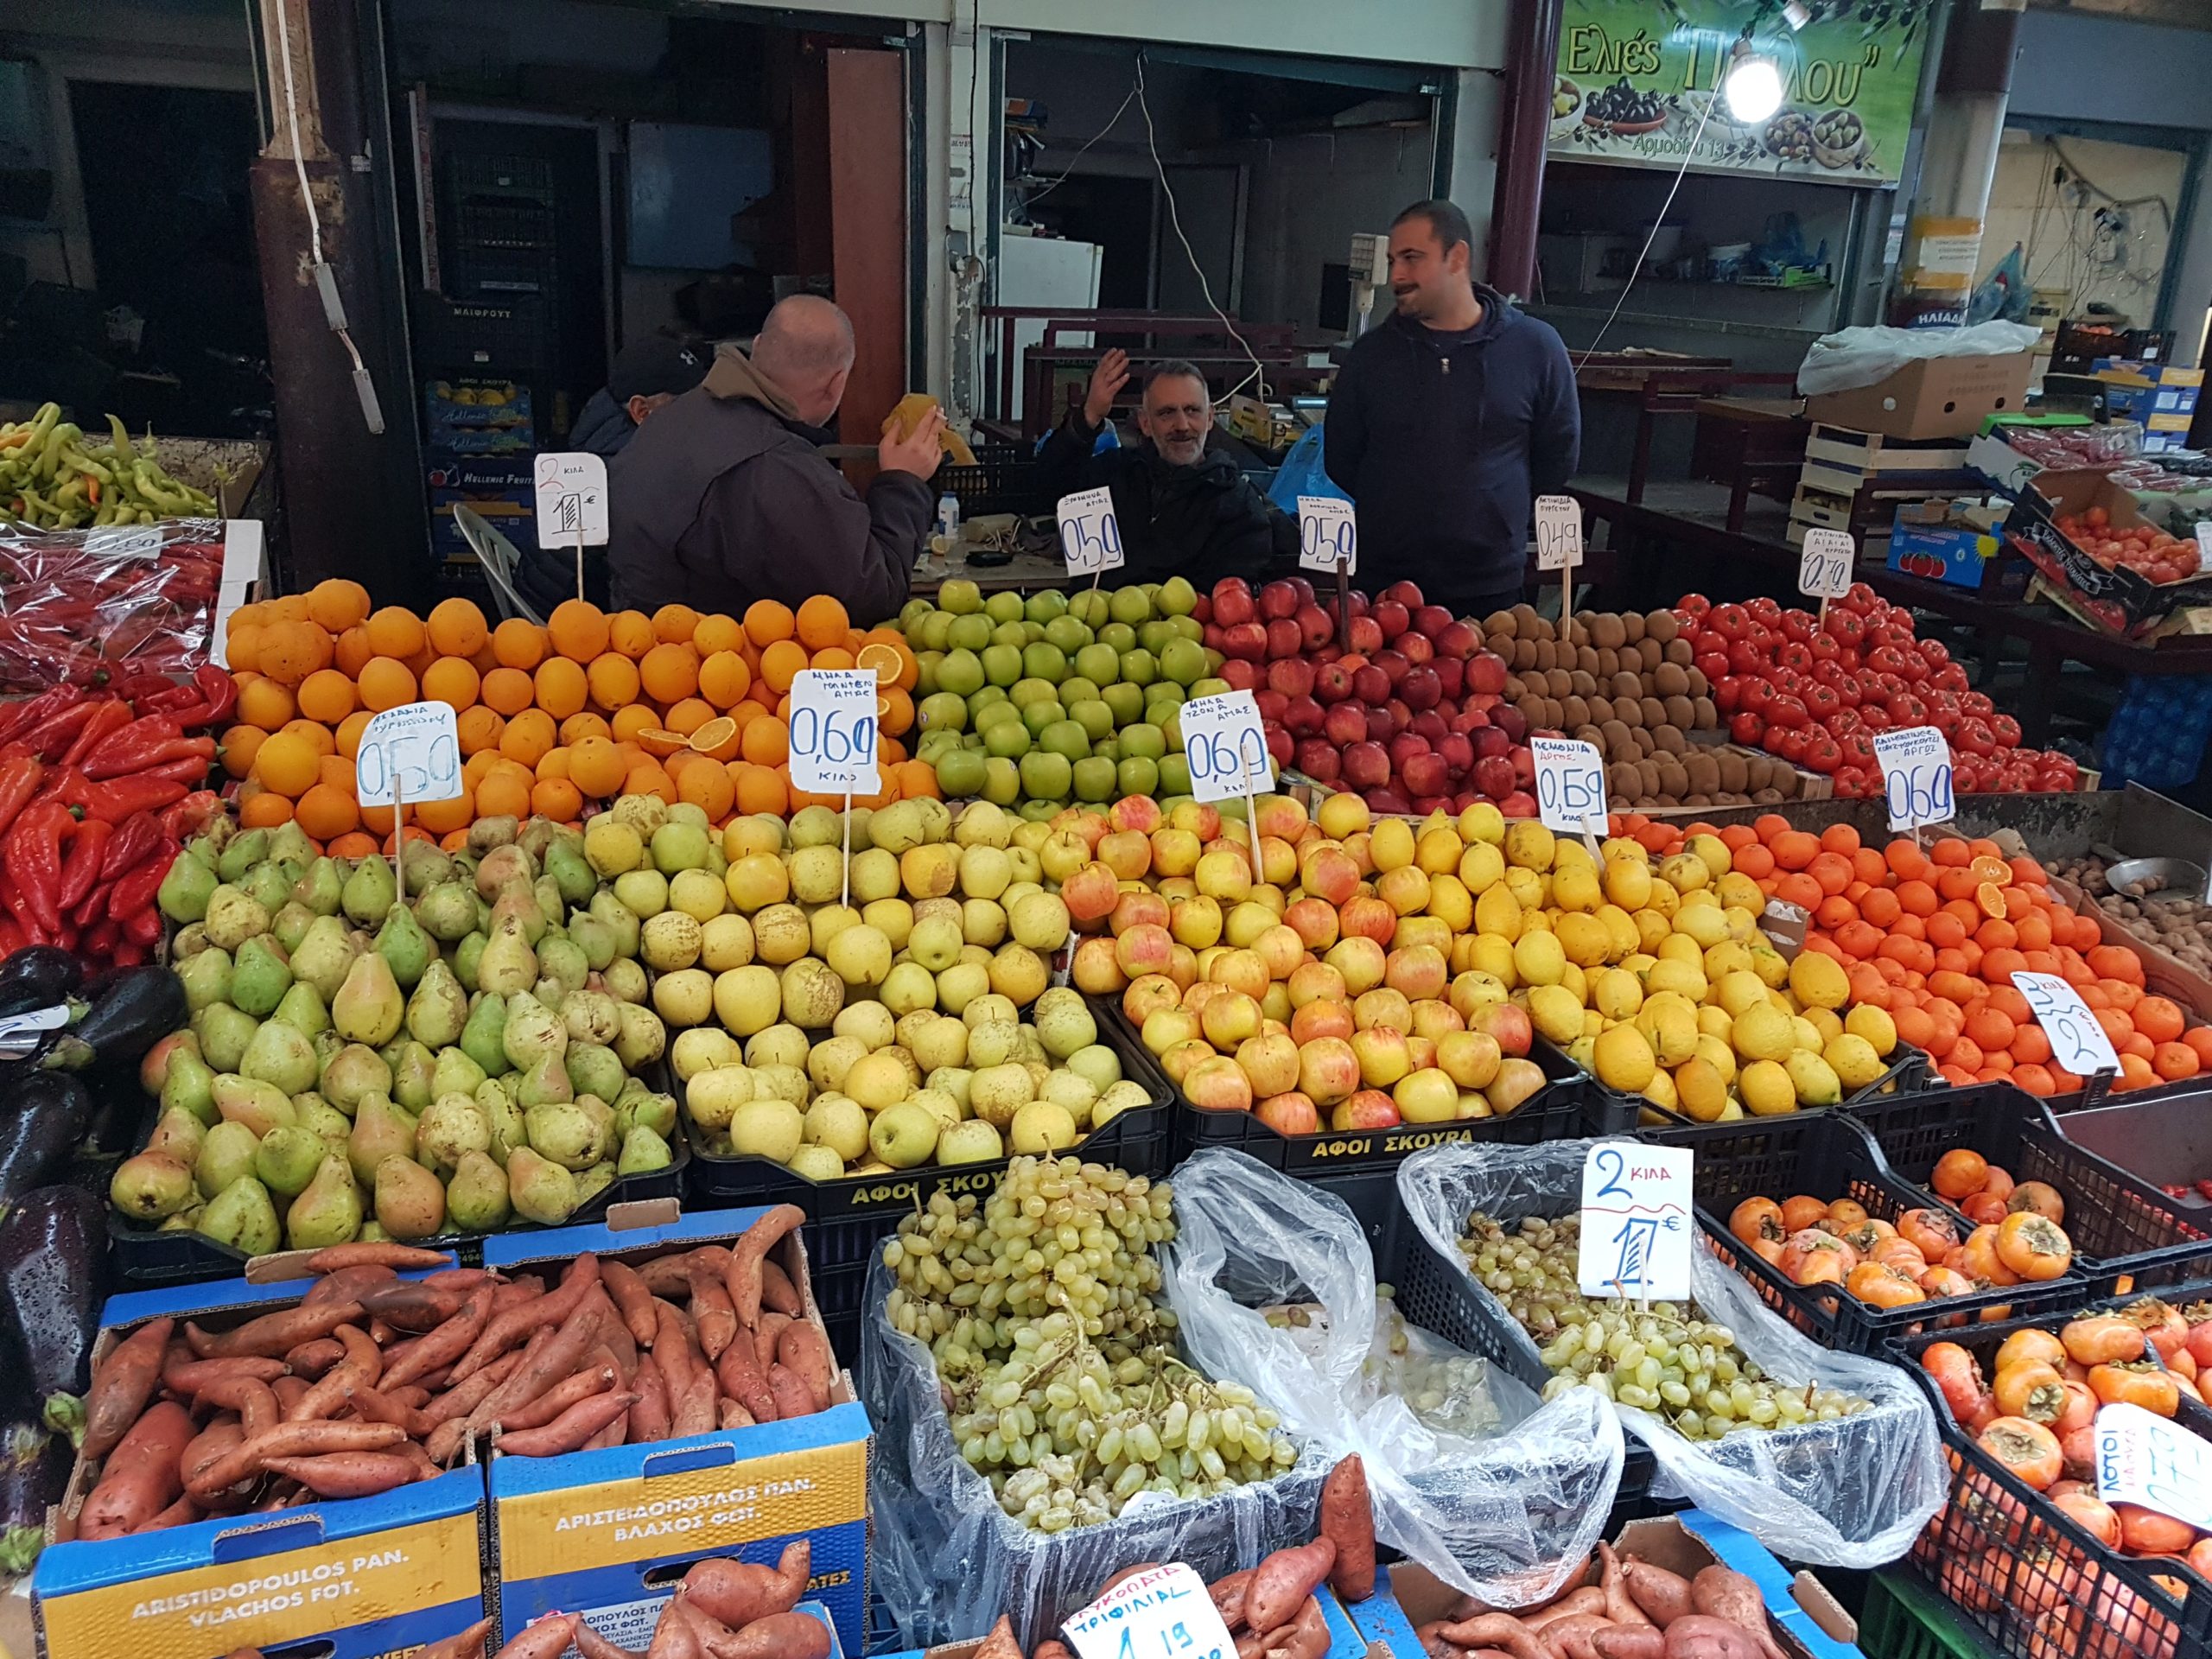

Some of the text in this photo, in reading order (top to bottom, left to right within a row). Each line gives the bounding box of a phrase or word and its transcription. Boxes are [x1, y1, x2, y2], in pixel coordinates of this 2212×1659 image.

[1568, 23, 1661, 74] Ελιές
[539, 458, 564, 488] 2
[1538, 520, 1579, 558] 0,49
[790, 707, 874, 766] 0,69
[1187, 727, 1267, 784] 0,69
[1312, 1138, 1372, 1158] ΑΦΟΙ
[850, 1181, 919, 1205] ΑΦΟΙ
[1596, 1149, 1672, 1199] 2 ΚΙΛΑ
[555, 1478, 817, 1532] ΑΡΙΣΤΕΙΔΟΠΟΥΛΟΣ ΠΑΝ.
[614, 1506, 763, 1542] ΒΛΑΧΟΣ ΦΩΤ.
[131, 1548, 410, 1619] ARISTIDOPOULOS PAN.
[188, 1580, 361, 1628] VLACHOS FOT.
[805, 1570, 850, 1592] ΑΤΕΣ
